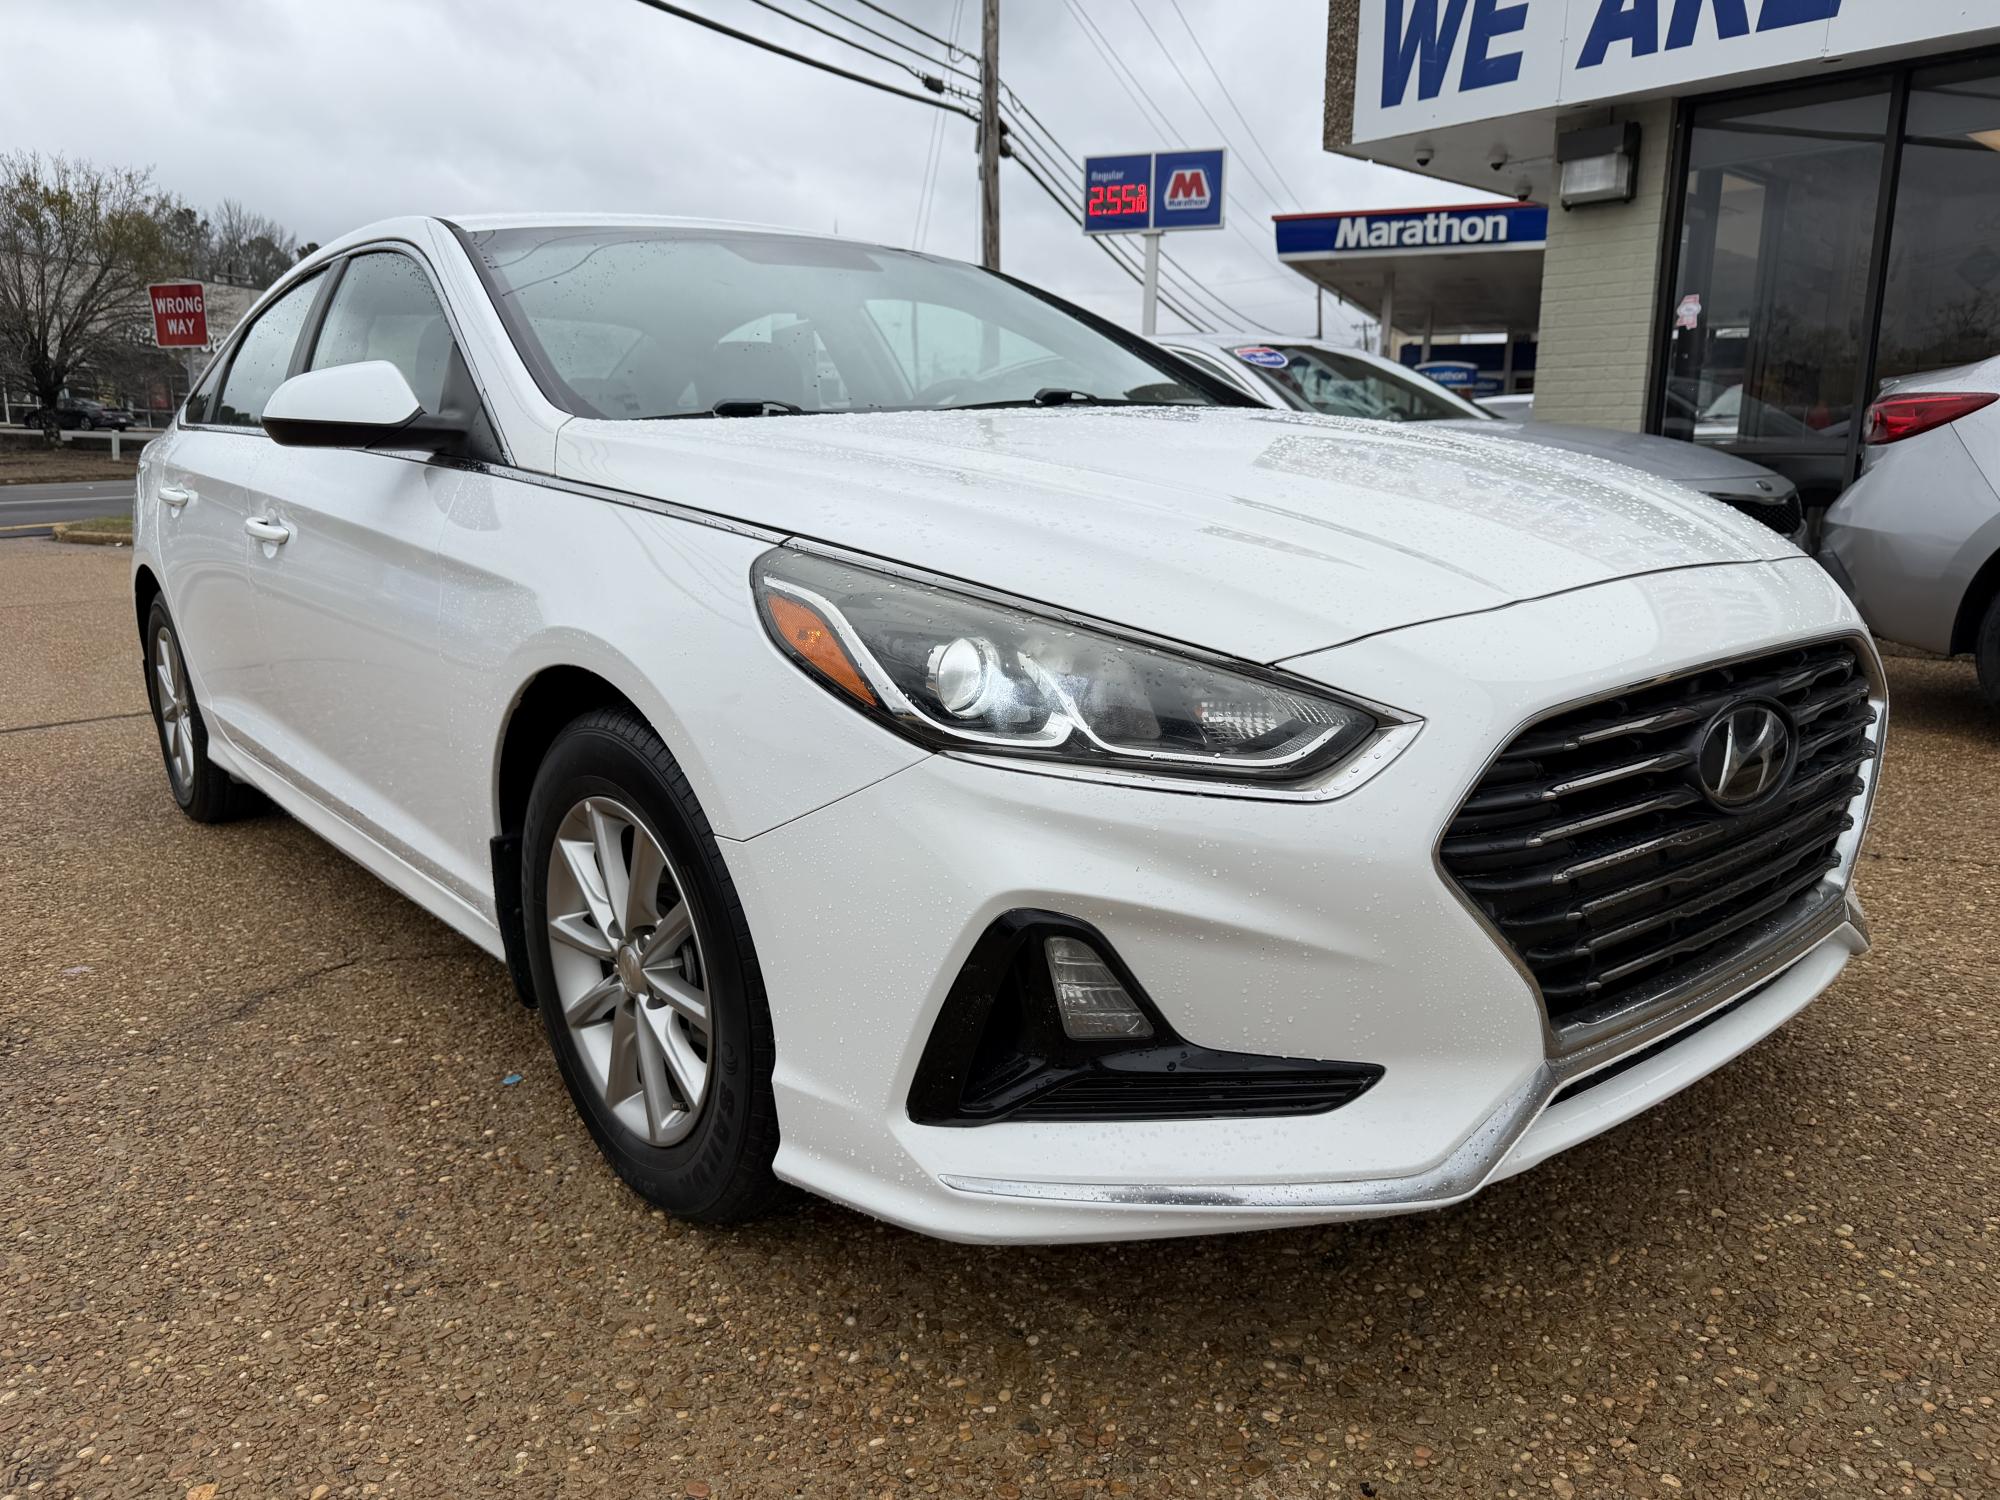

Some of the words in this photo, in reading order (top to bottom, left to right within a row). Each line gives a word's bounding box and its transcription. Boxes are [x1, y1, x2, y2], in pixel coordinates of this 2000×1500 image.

[1381, 0, 1529, 108] WE
[1334, 212, 1508, 249] Marathon
[155, 296, 202, 314] WRONG
[167, 318, 195, 335] WAY
